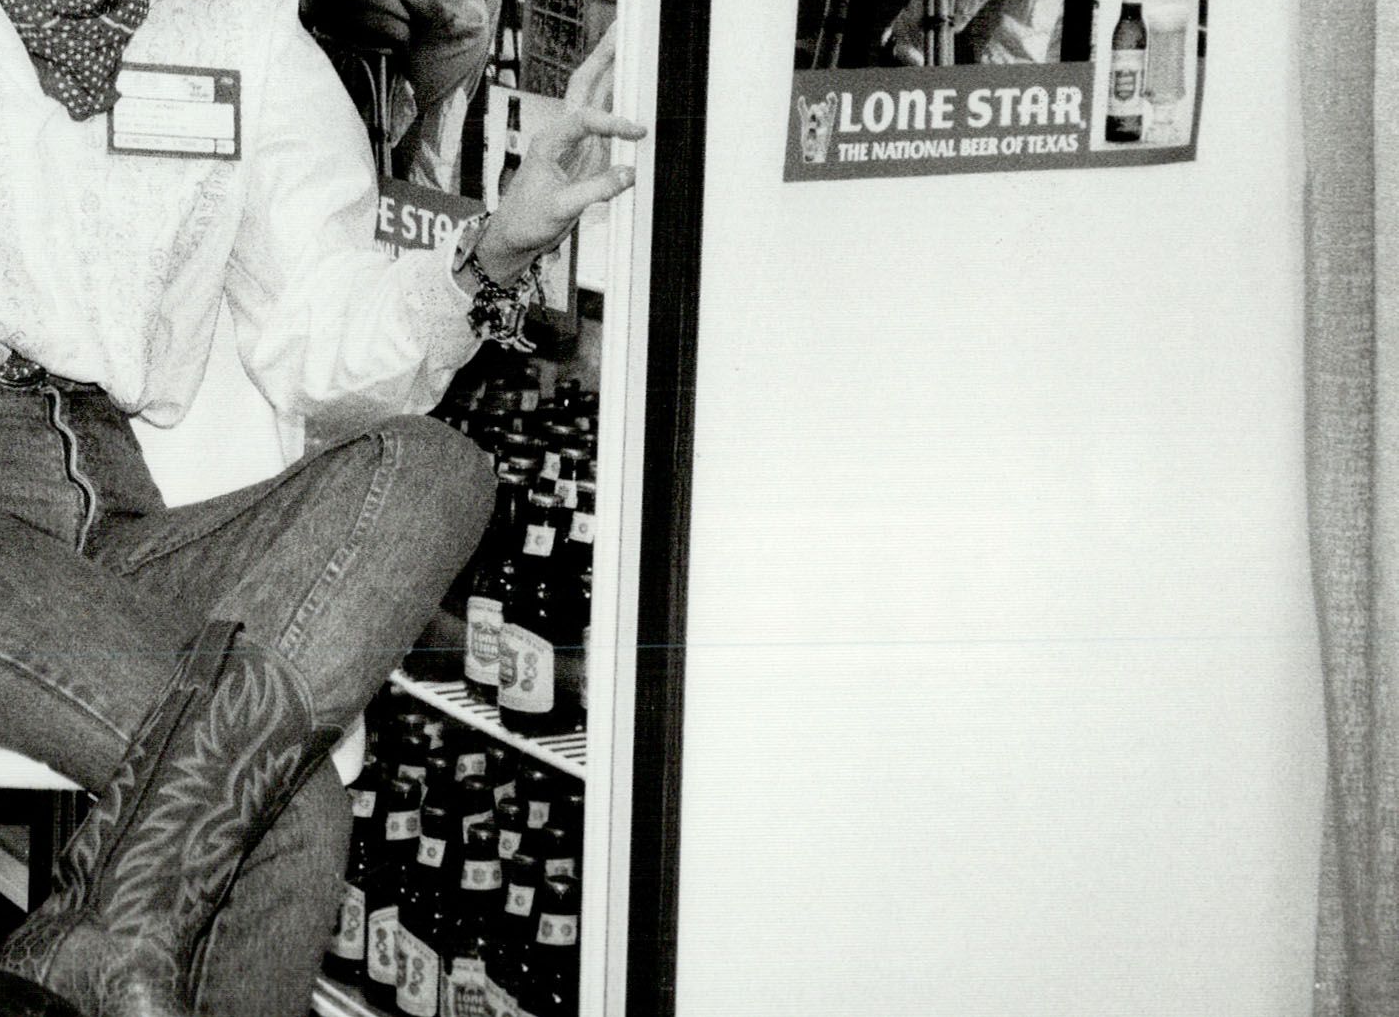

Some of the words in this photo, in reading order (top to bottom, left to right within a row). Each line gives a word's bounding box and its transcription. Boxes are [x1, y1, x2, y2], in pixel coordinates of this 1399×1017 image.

[837, 88, 958, 133] LONE
[966, 85, 1084, 128] STAR
[838, 142, 869, 162] THE
[870, 139, 956, 161] NATIONAL
[959, 137, 999, 157] BEER
[1002, 135, 1025, 155] OF
[1025, 134, 1080, 154] TEXAS
[401, 204, 454, 249] STA
